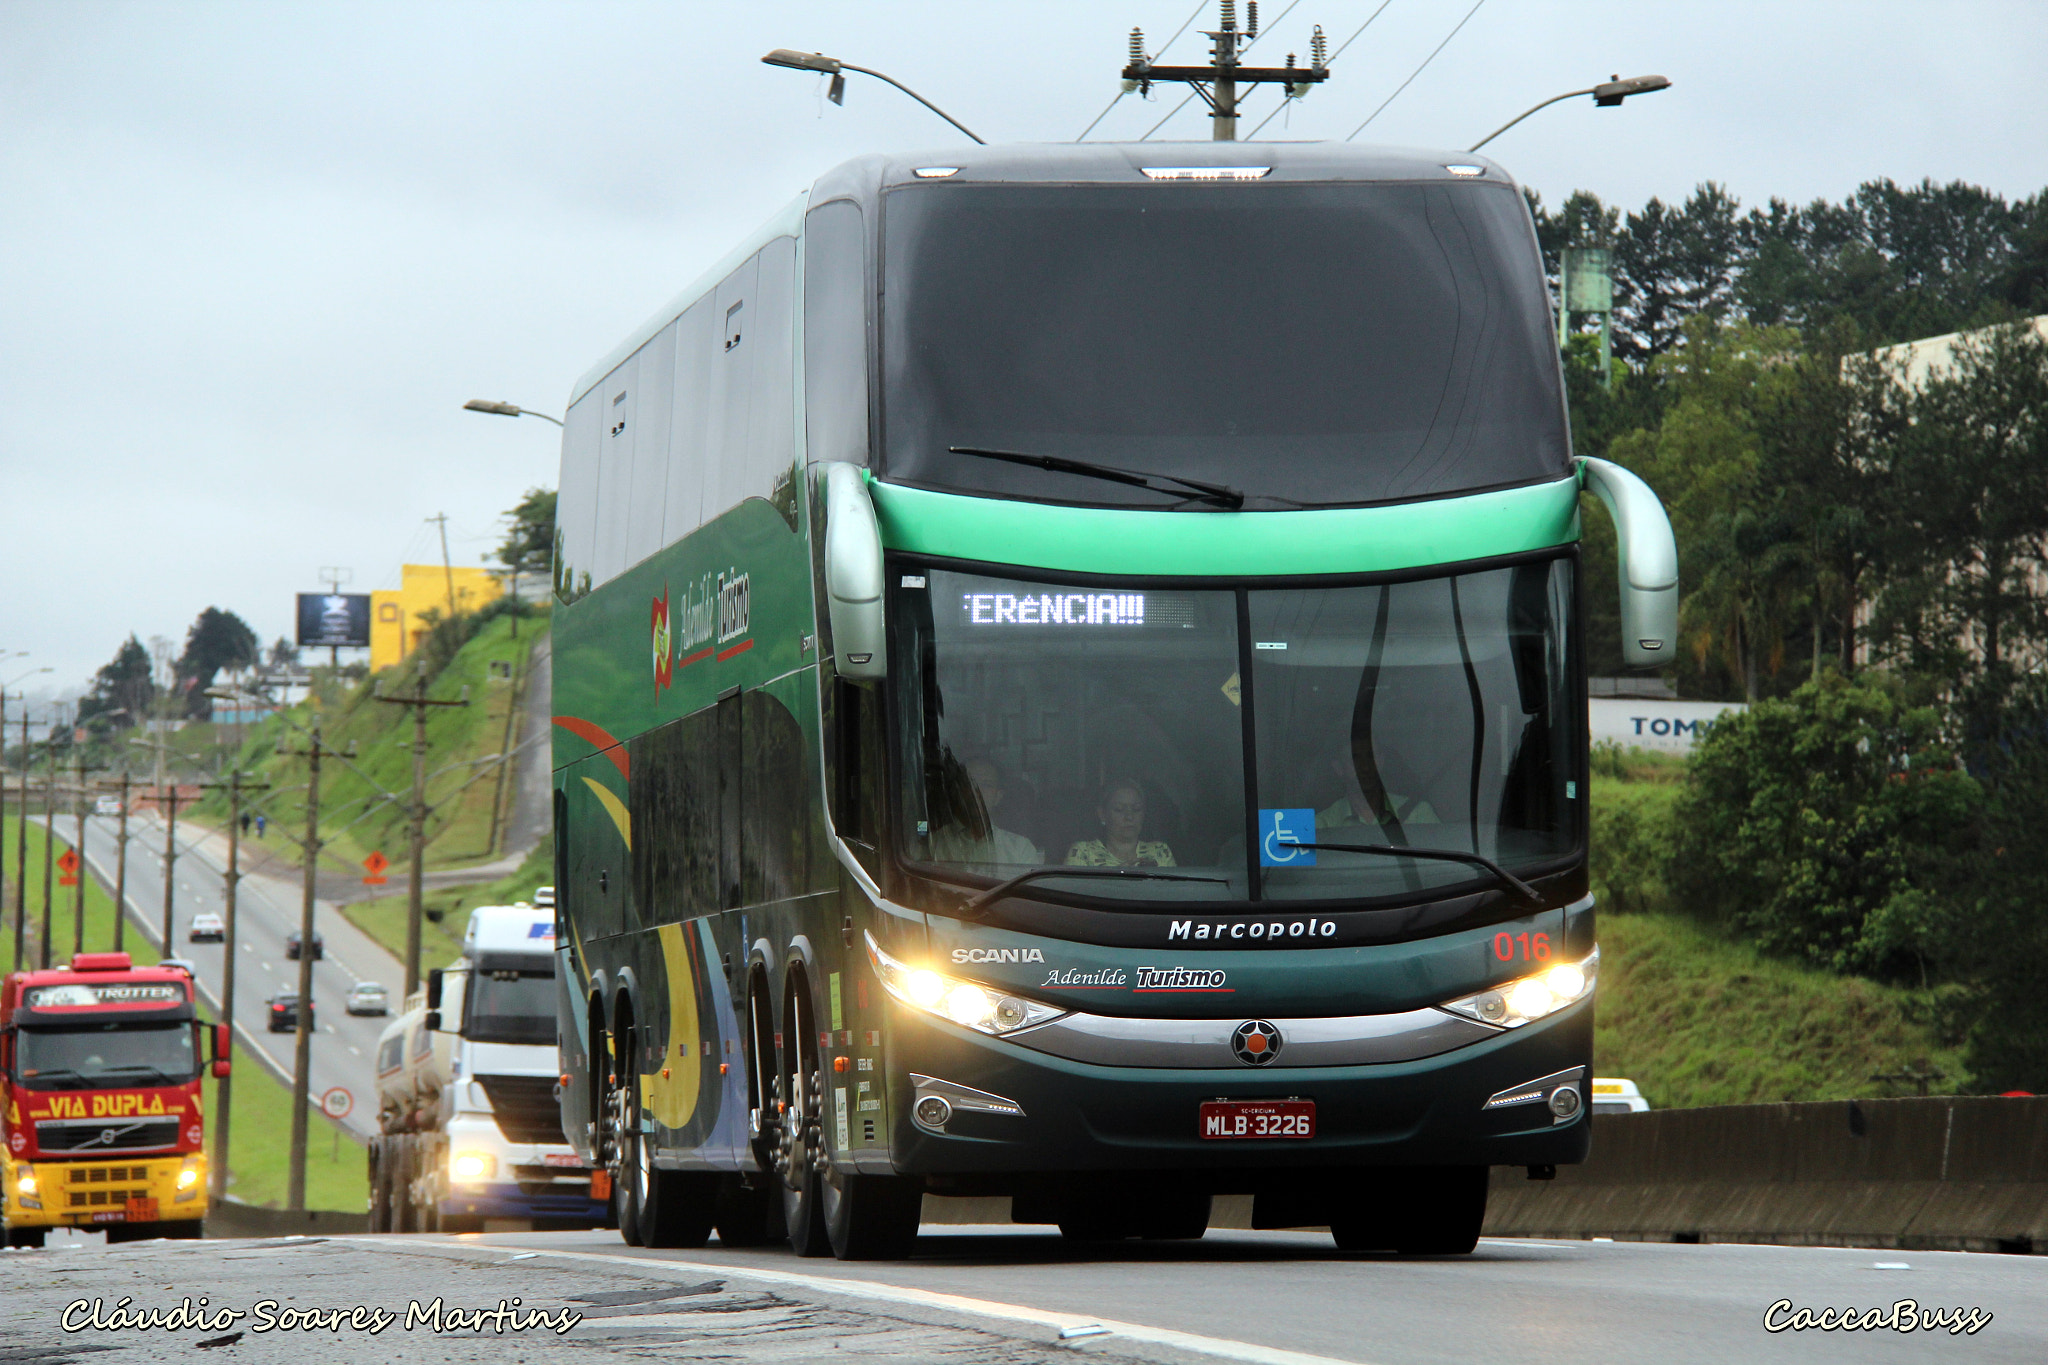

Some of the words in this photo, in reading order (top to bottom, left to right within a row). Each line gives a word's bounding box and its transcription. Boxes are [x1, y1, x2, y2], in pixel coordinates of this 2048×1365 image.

[718, 566, 750, 644] Turismo
[1630, 717, 1715, 737] TOM
[1168, 918, 1336, 941] Marcopolo
[951, 948, 1045, 964] SCANIA
[1494, 932, 1552, 962] 016
[1041, 968, 1127, 986] Adenilde
[1136, 966, 1226, 988] Turismo
[48, 1096, 87, 1118] VIA
[92, 1094, 165, 1117] DUPLA
